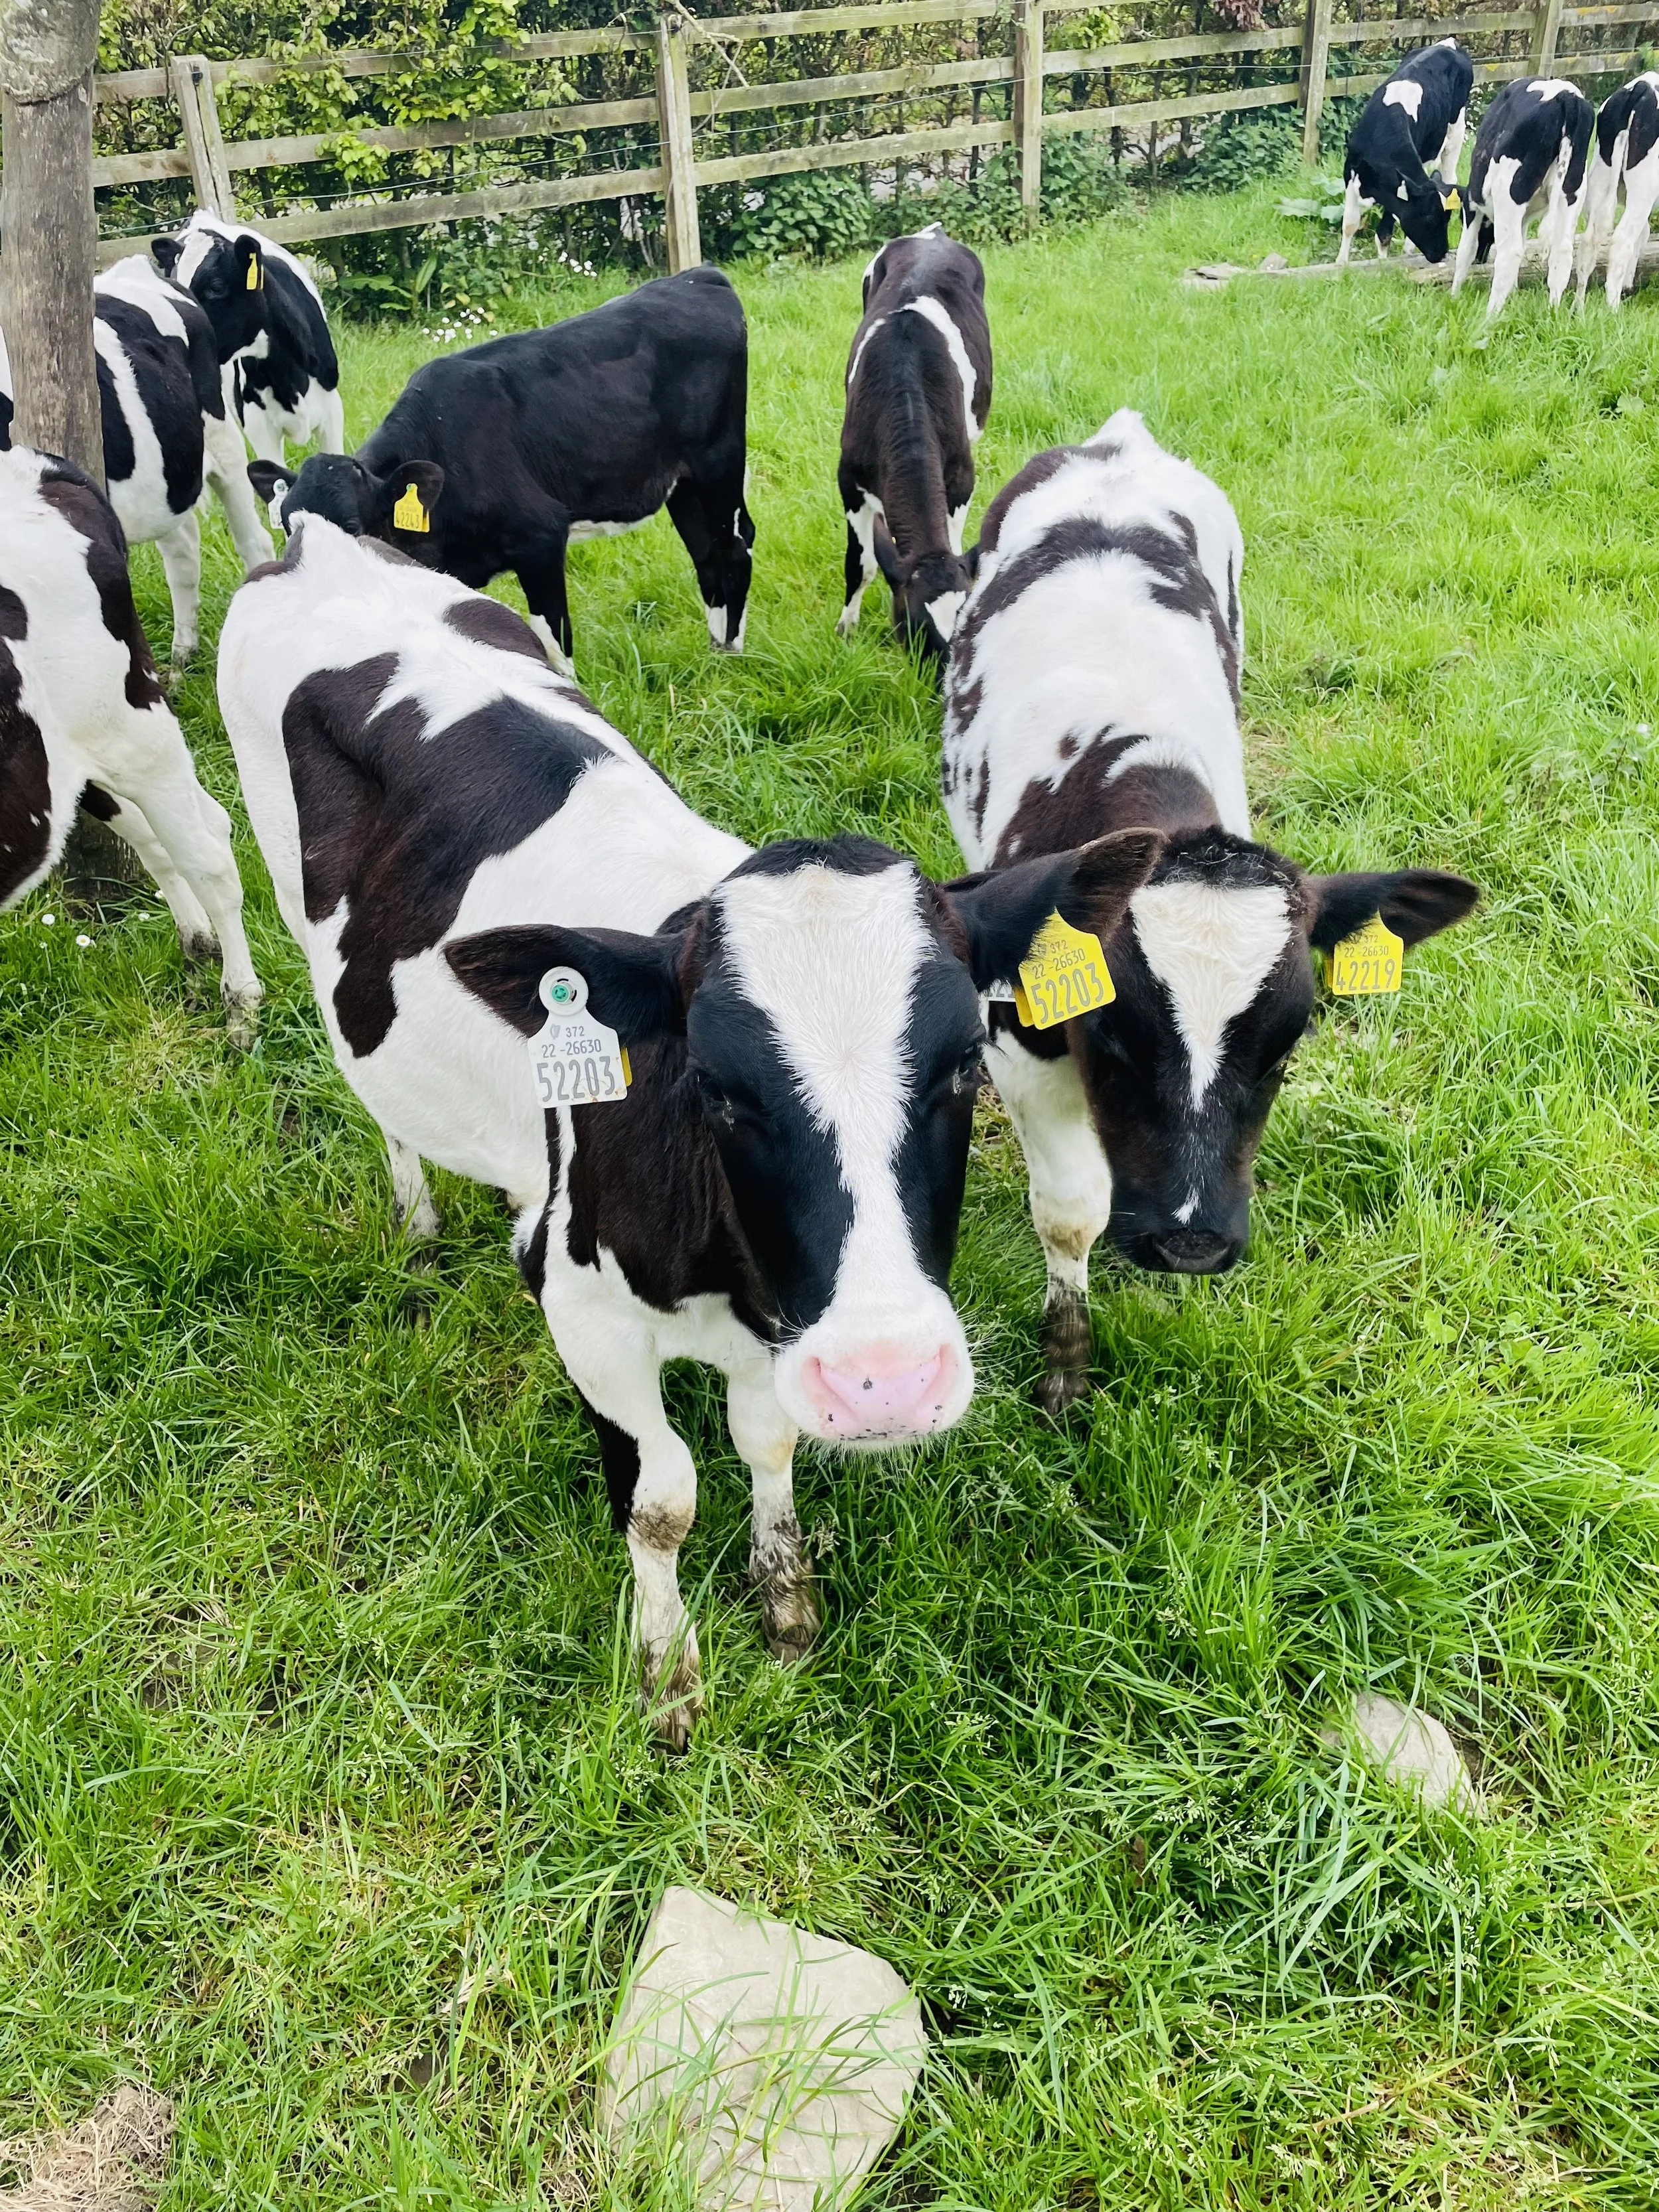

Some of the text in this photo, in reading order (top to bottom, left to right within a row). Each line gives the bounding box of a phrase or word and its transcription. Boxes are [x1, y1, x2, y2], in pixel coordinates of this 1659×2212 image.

[1050, 940, 1068, 954] 372
[1336, 959, 1396, 991] 42219
[1031, 962, 1104, 1023] 52203
[565, 1026, 585, 1037] 372
[537, 1056, 615, 1102] 52203
